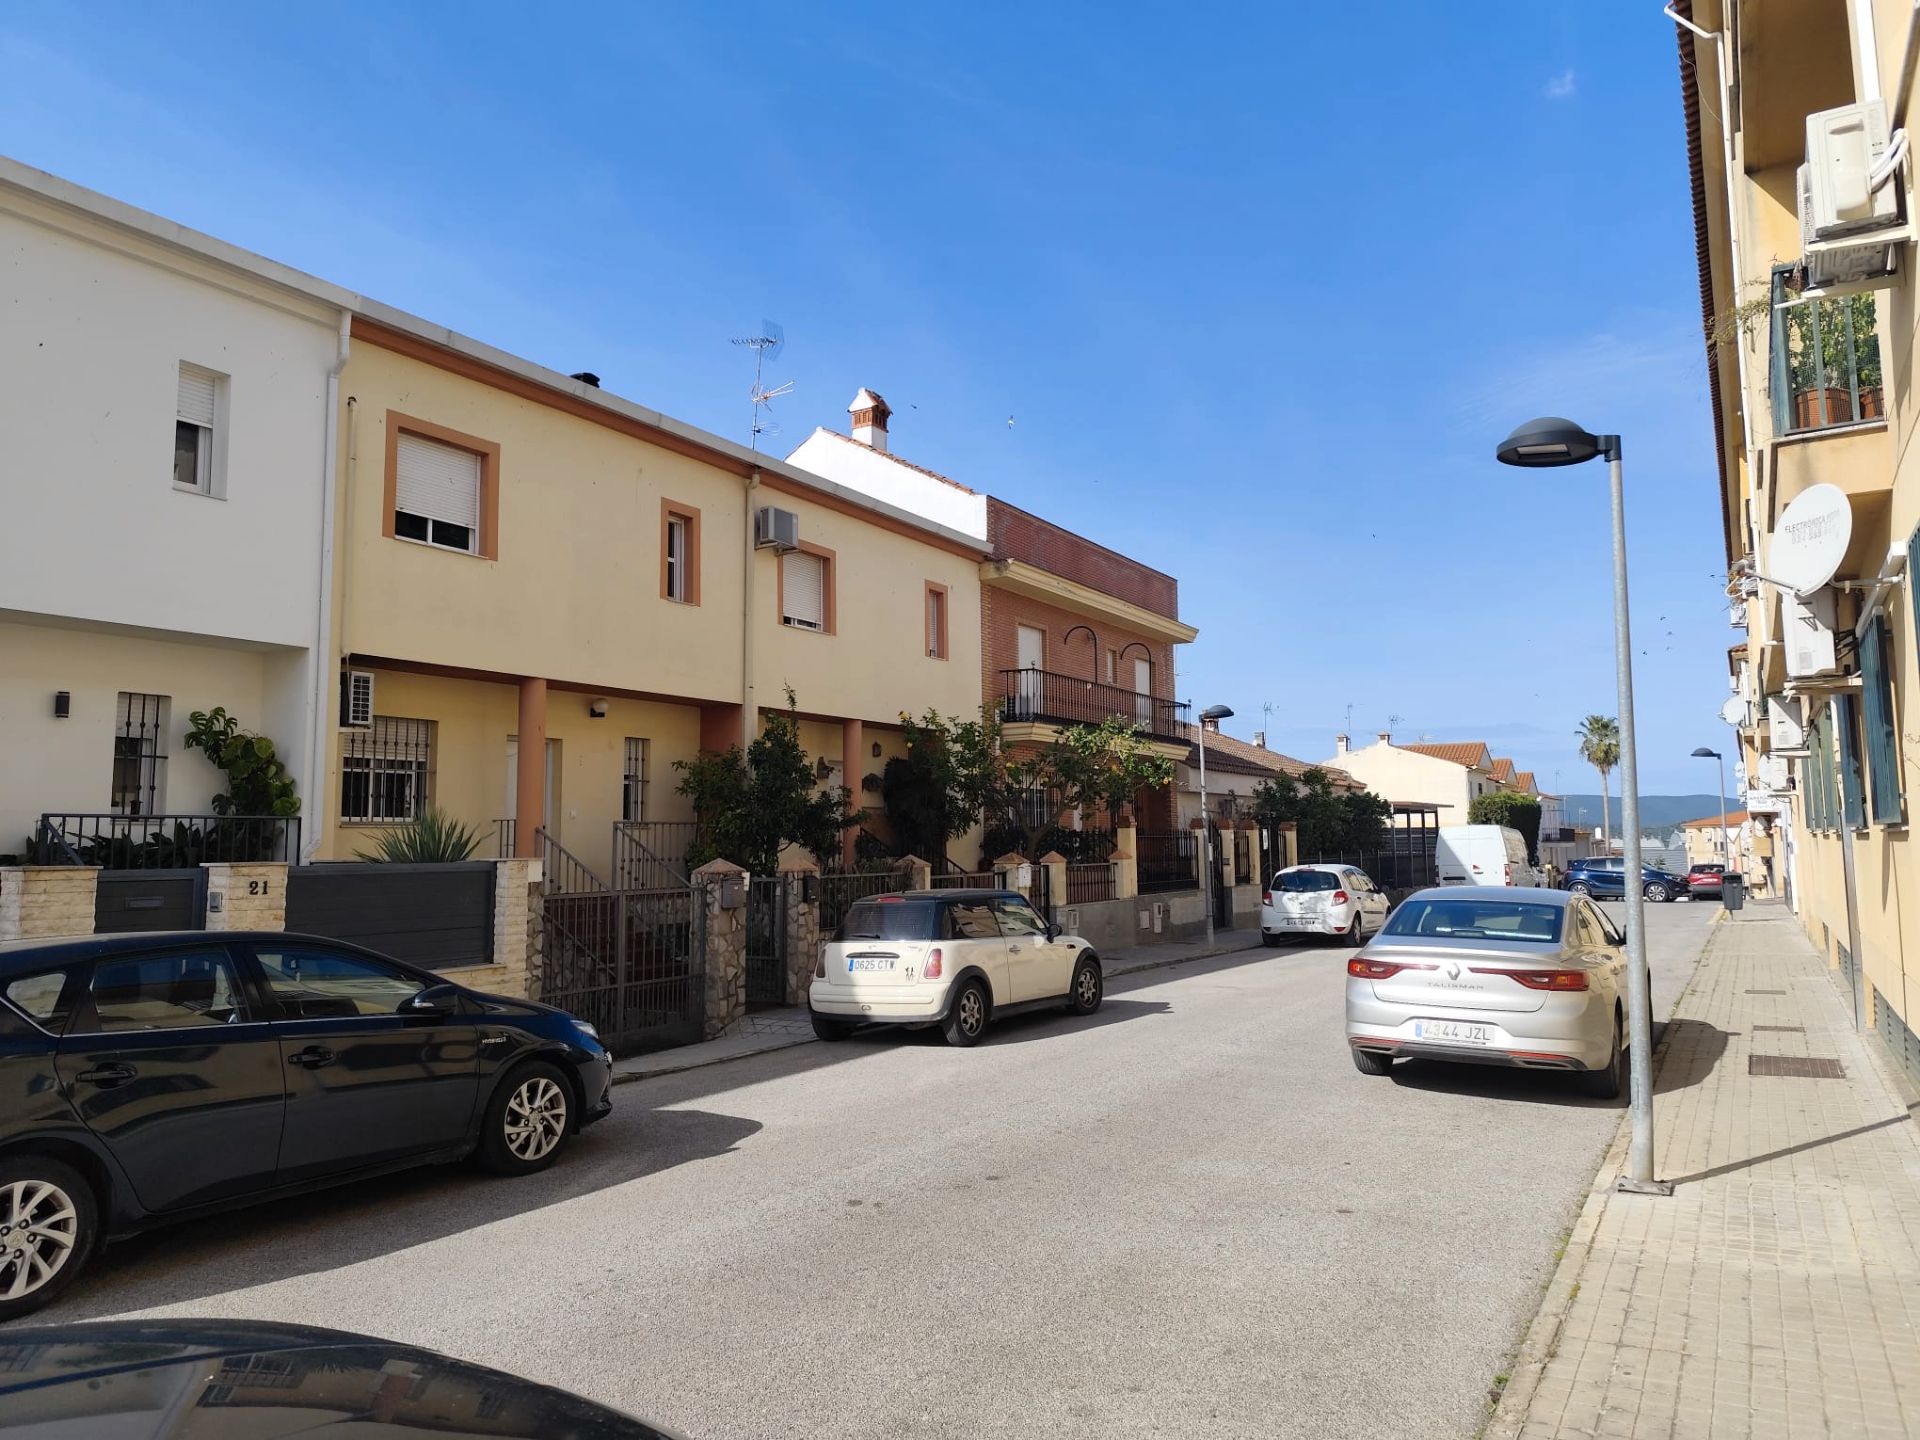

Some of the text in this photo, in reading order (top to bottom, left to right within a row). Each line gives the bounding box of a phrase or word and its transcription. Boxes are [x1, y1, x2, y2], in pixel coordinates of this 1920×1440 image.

[249, 880, 268, 895] 21
[854, 960, 875, 970] 0625
[1465, 1026, 1491, 1041] JZL
